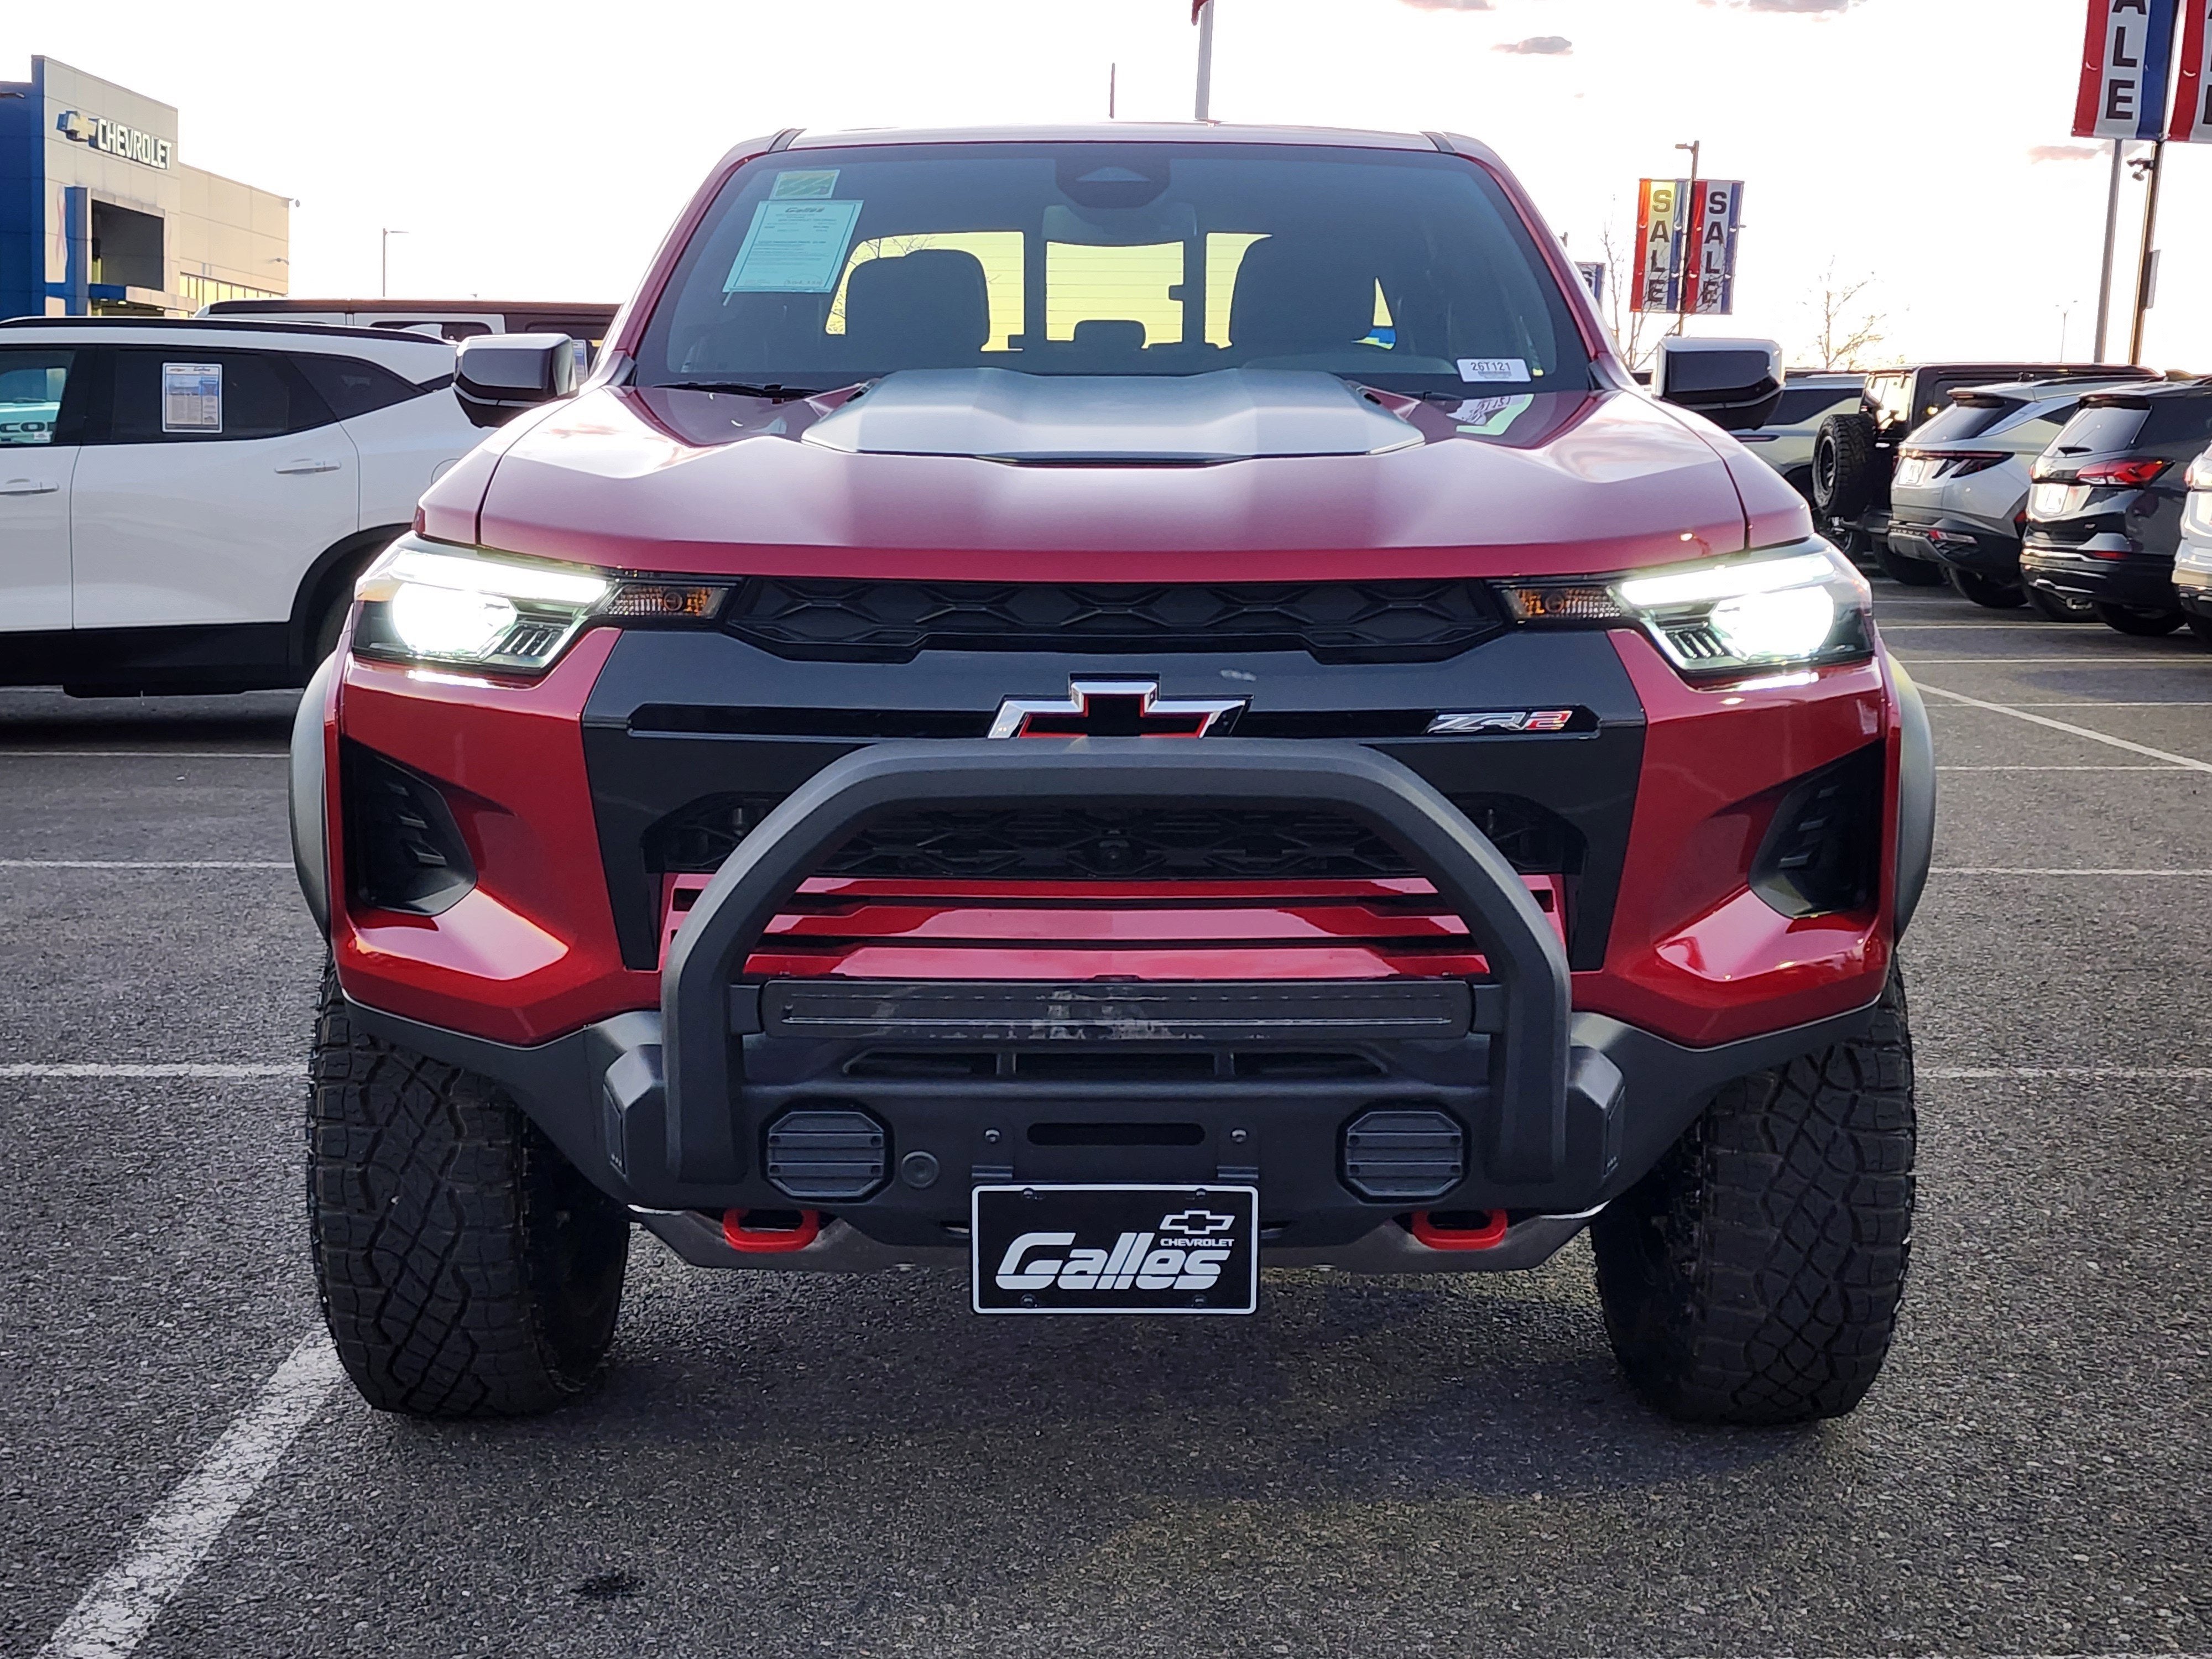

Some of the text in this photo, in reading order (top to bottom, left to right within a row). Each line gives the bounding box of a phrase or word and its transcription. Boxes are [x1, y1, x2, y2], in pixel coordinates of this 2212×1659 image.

[98, 118, 172, 170] CHEVROLET
[1648, 189, 1672, 302] SALE
[1702, 191, 1728, 304] SALE
[1470, 362, 1510, 371] 26T121
[1427, 710, 1573, 734] ZR2
[996, 1233, 1230, 1289] Galles
[1160, 1238, 1234, 1247] CHEVROLET
